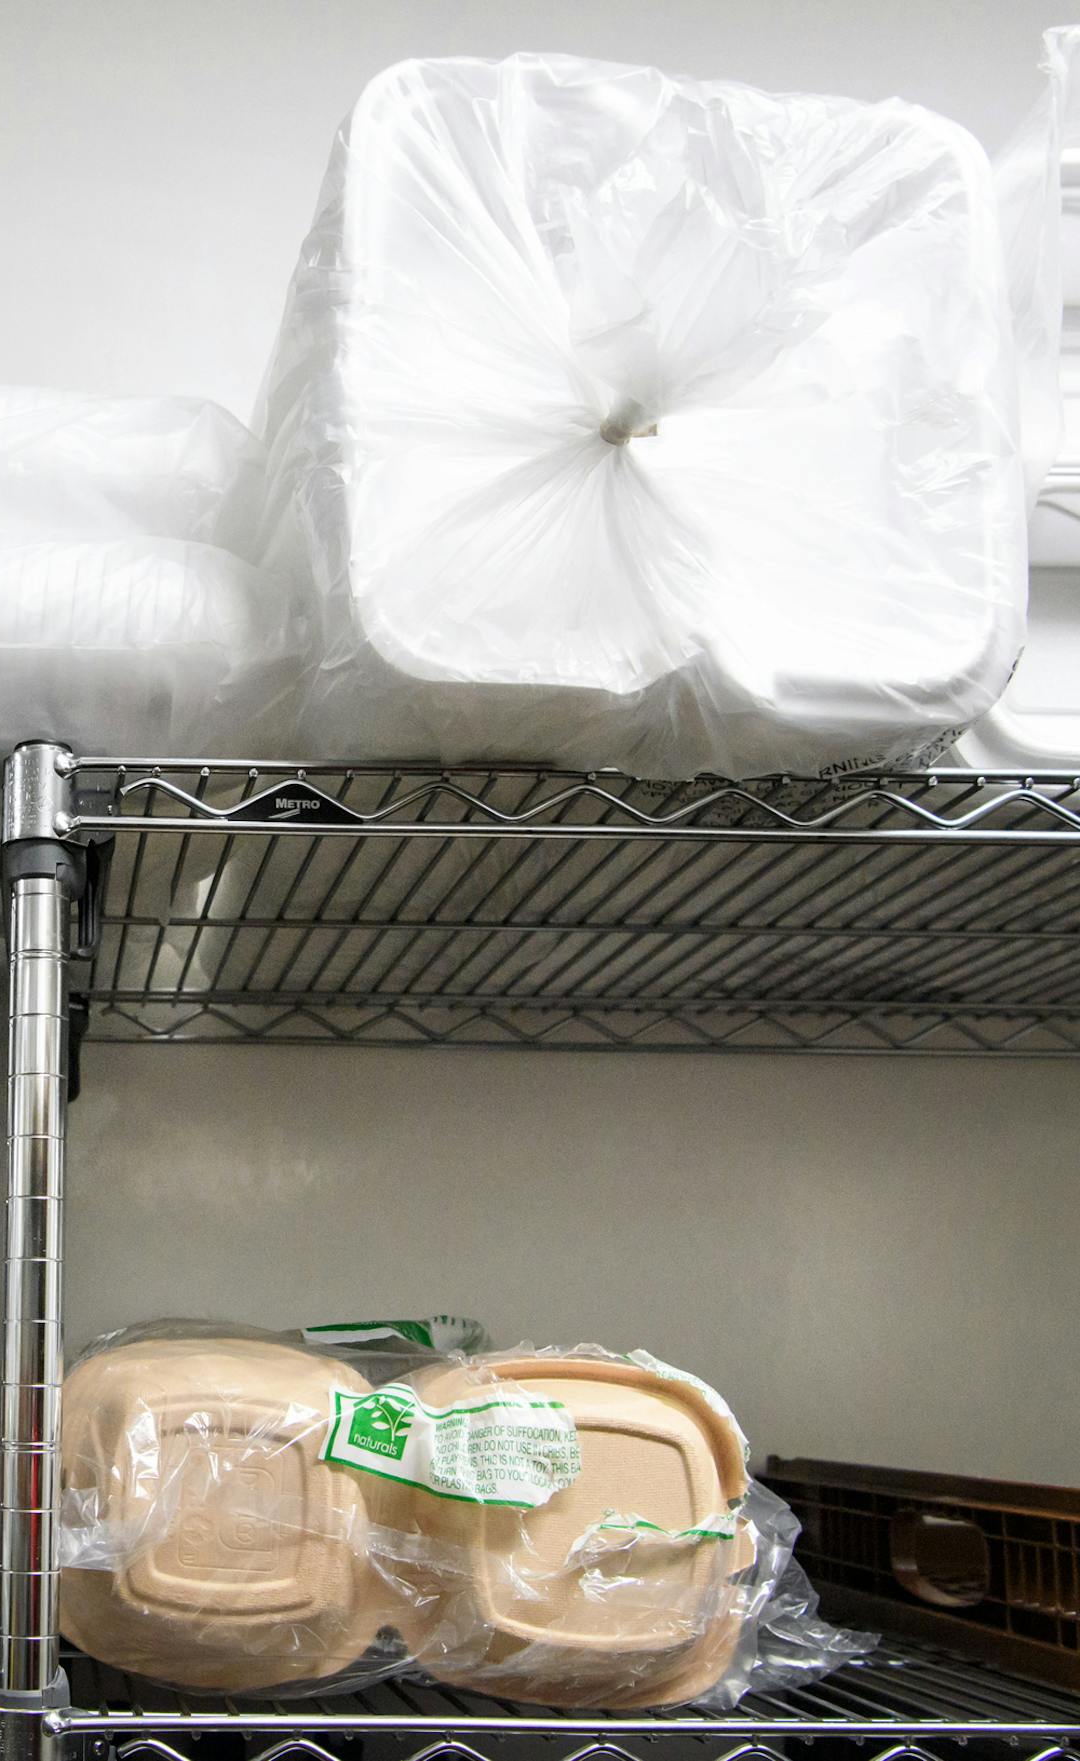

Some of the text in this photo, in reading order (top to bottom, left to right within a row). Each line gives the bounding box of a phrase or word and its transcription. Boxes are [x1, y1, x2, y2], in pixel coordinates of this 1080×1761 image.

[819, 754, 884, 779] RNING
[276, 798, 320, 809] METRO
[494, 1426, 505, 1436] OF
[354, 1433, 398, 1455] naturals
[484, 1440, 496, 1451] DO
[498, 1440, 514, 1451] NOT
[516, 1442, 531, 1455] USE
[500, 1454, 507, 1465] IS
[551, 1463, 569, 1474] THIS
[476, 1468, 493, 1480] BAG
[494, 1468, 505, 1480] TO
